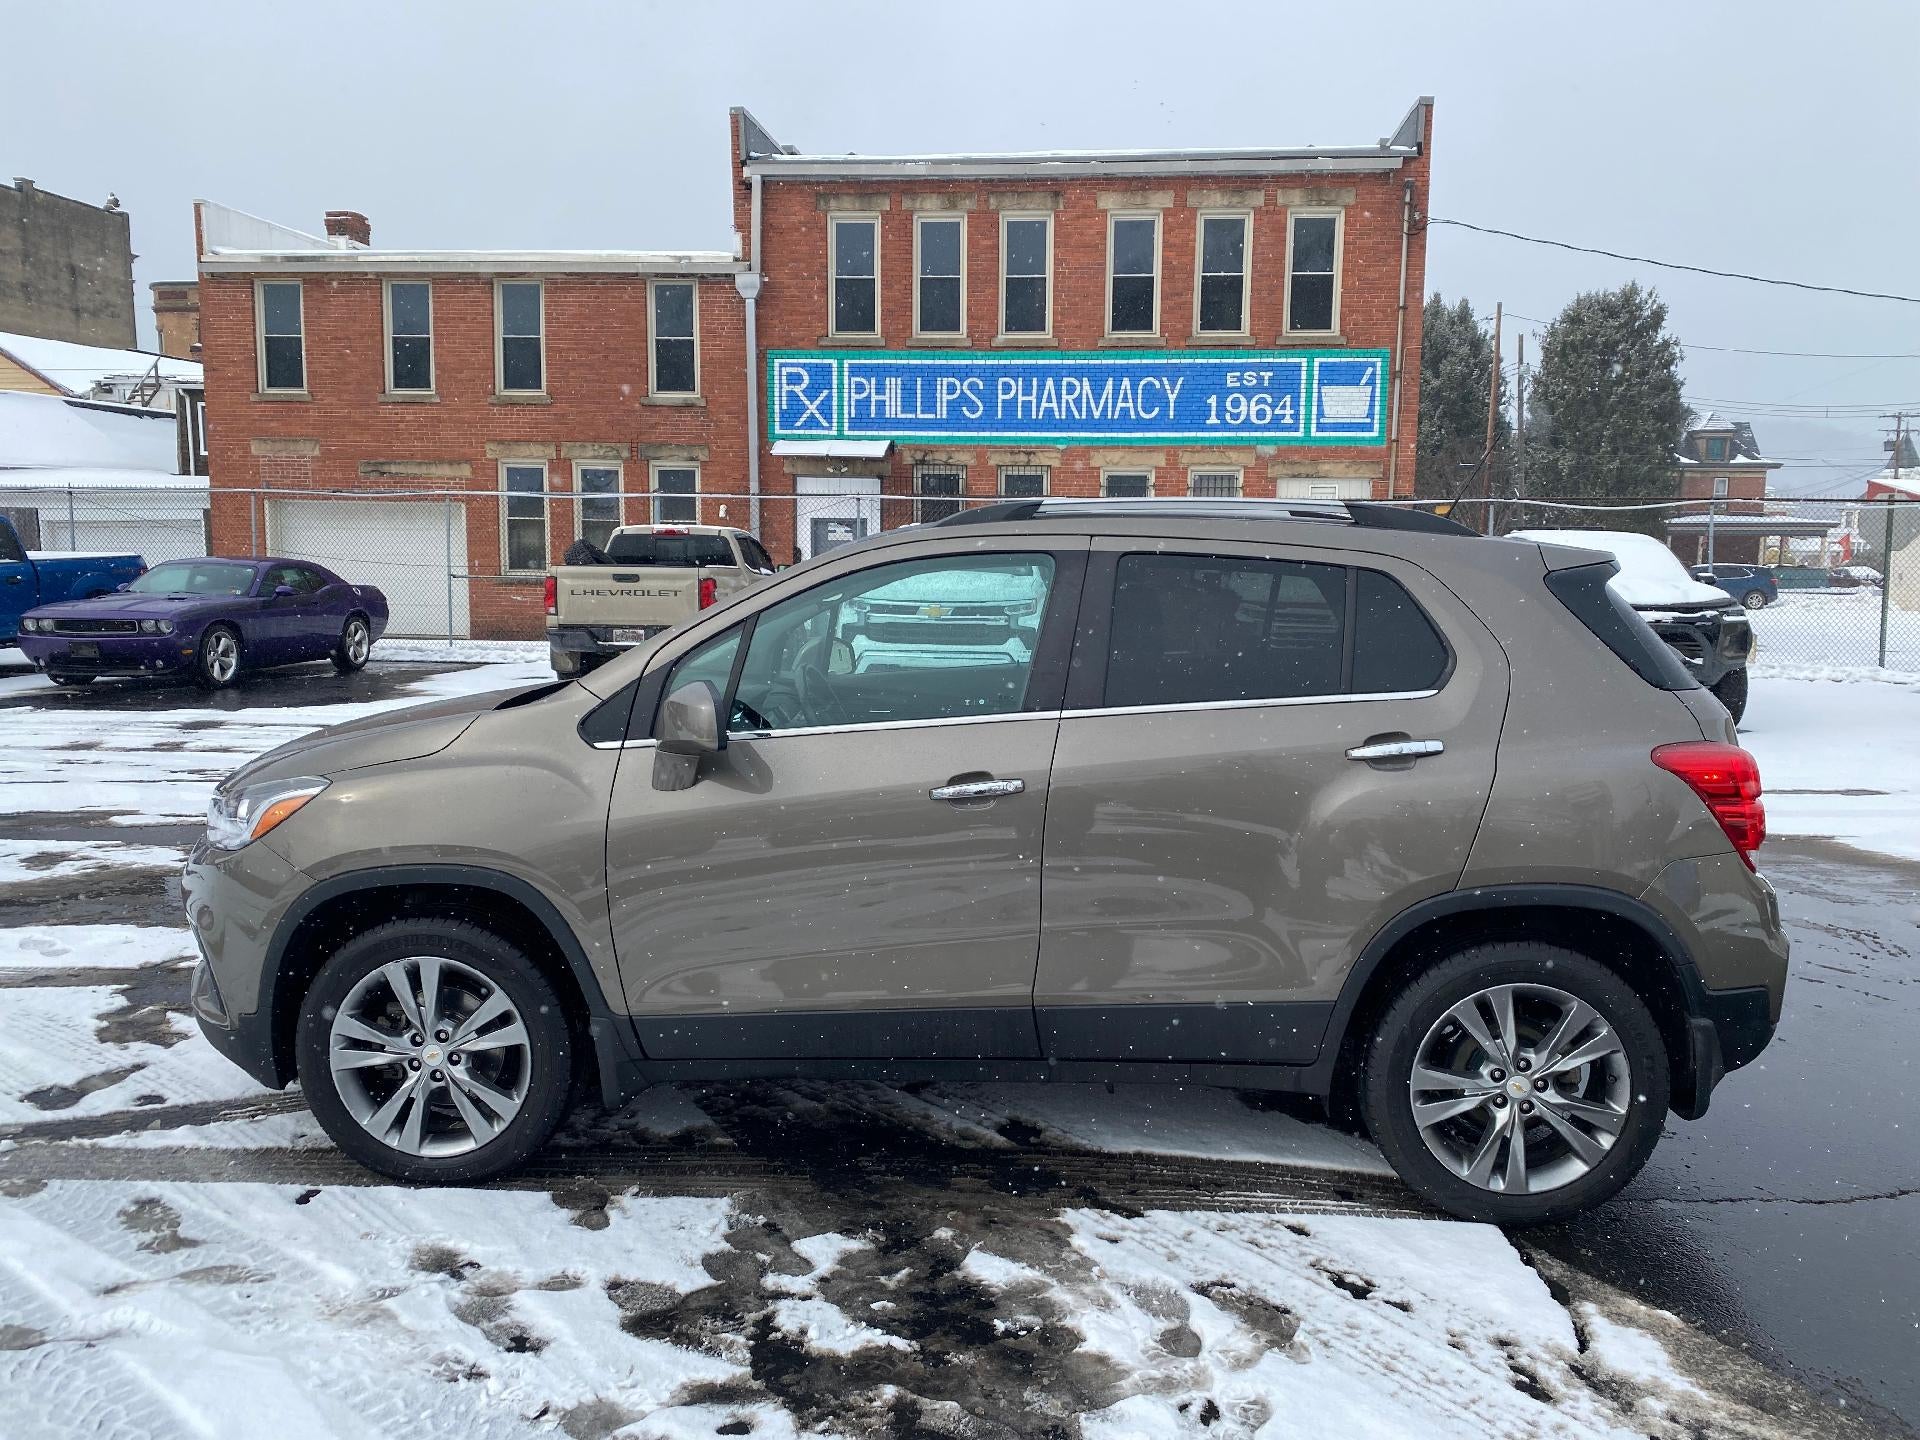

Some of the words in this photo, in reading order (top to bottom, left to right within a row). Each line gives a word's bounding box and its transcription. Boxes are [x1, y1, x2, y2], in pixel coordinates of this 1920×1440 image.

[1226, 371, 1274, 388] EST
[850, 376, 984, 419] PHILLIPS
[997, 376, 1184, 419] PHARMACY
[1205, 393, 1295, 424] 1964
[570, 589, 682, 597] CHEVROLET
